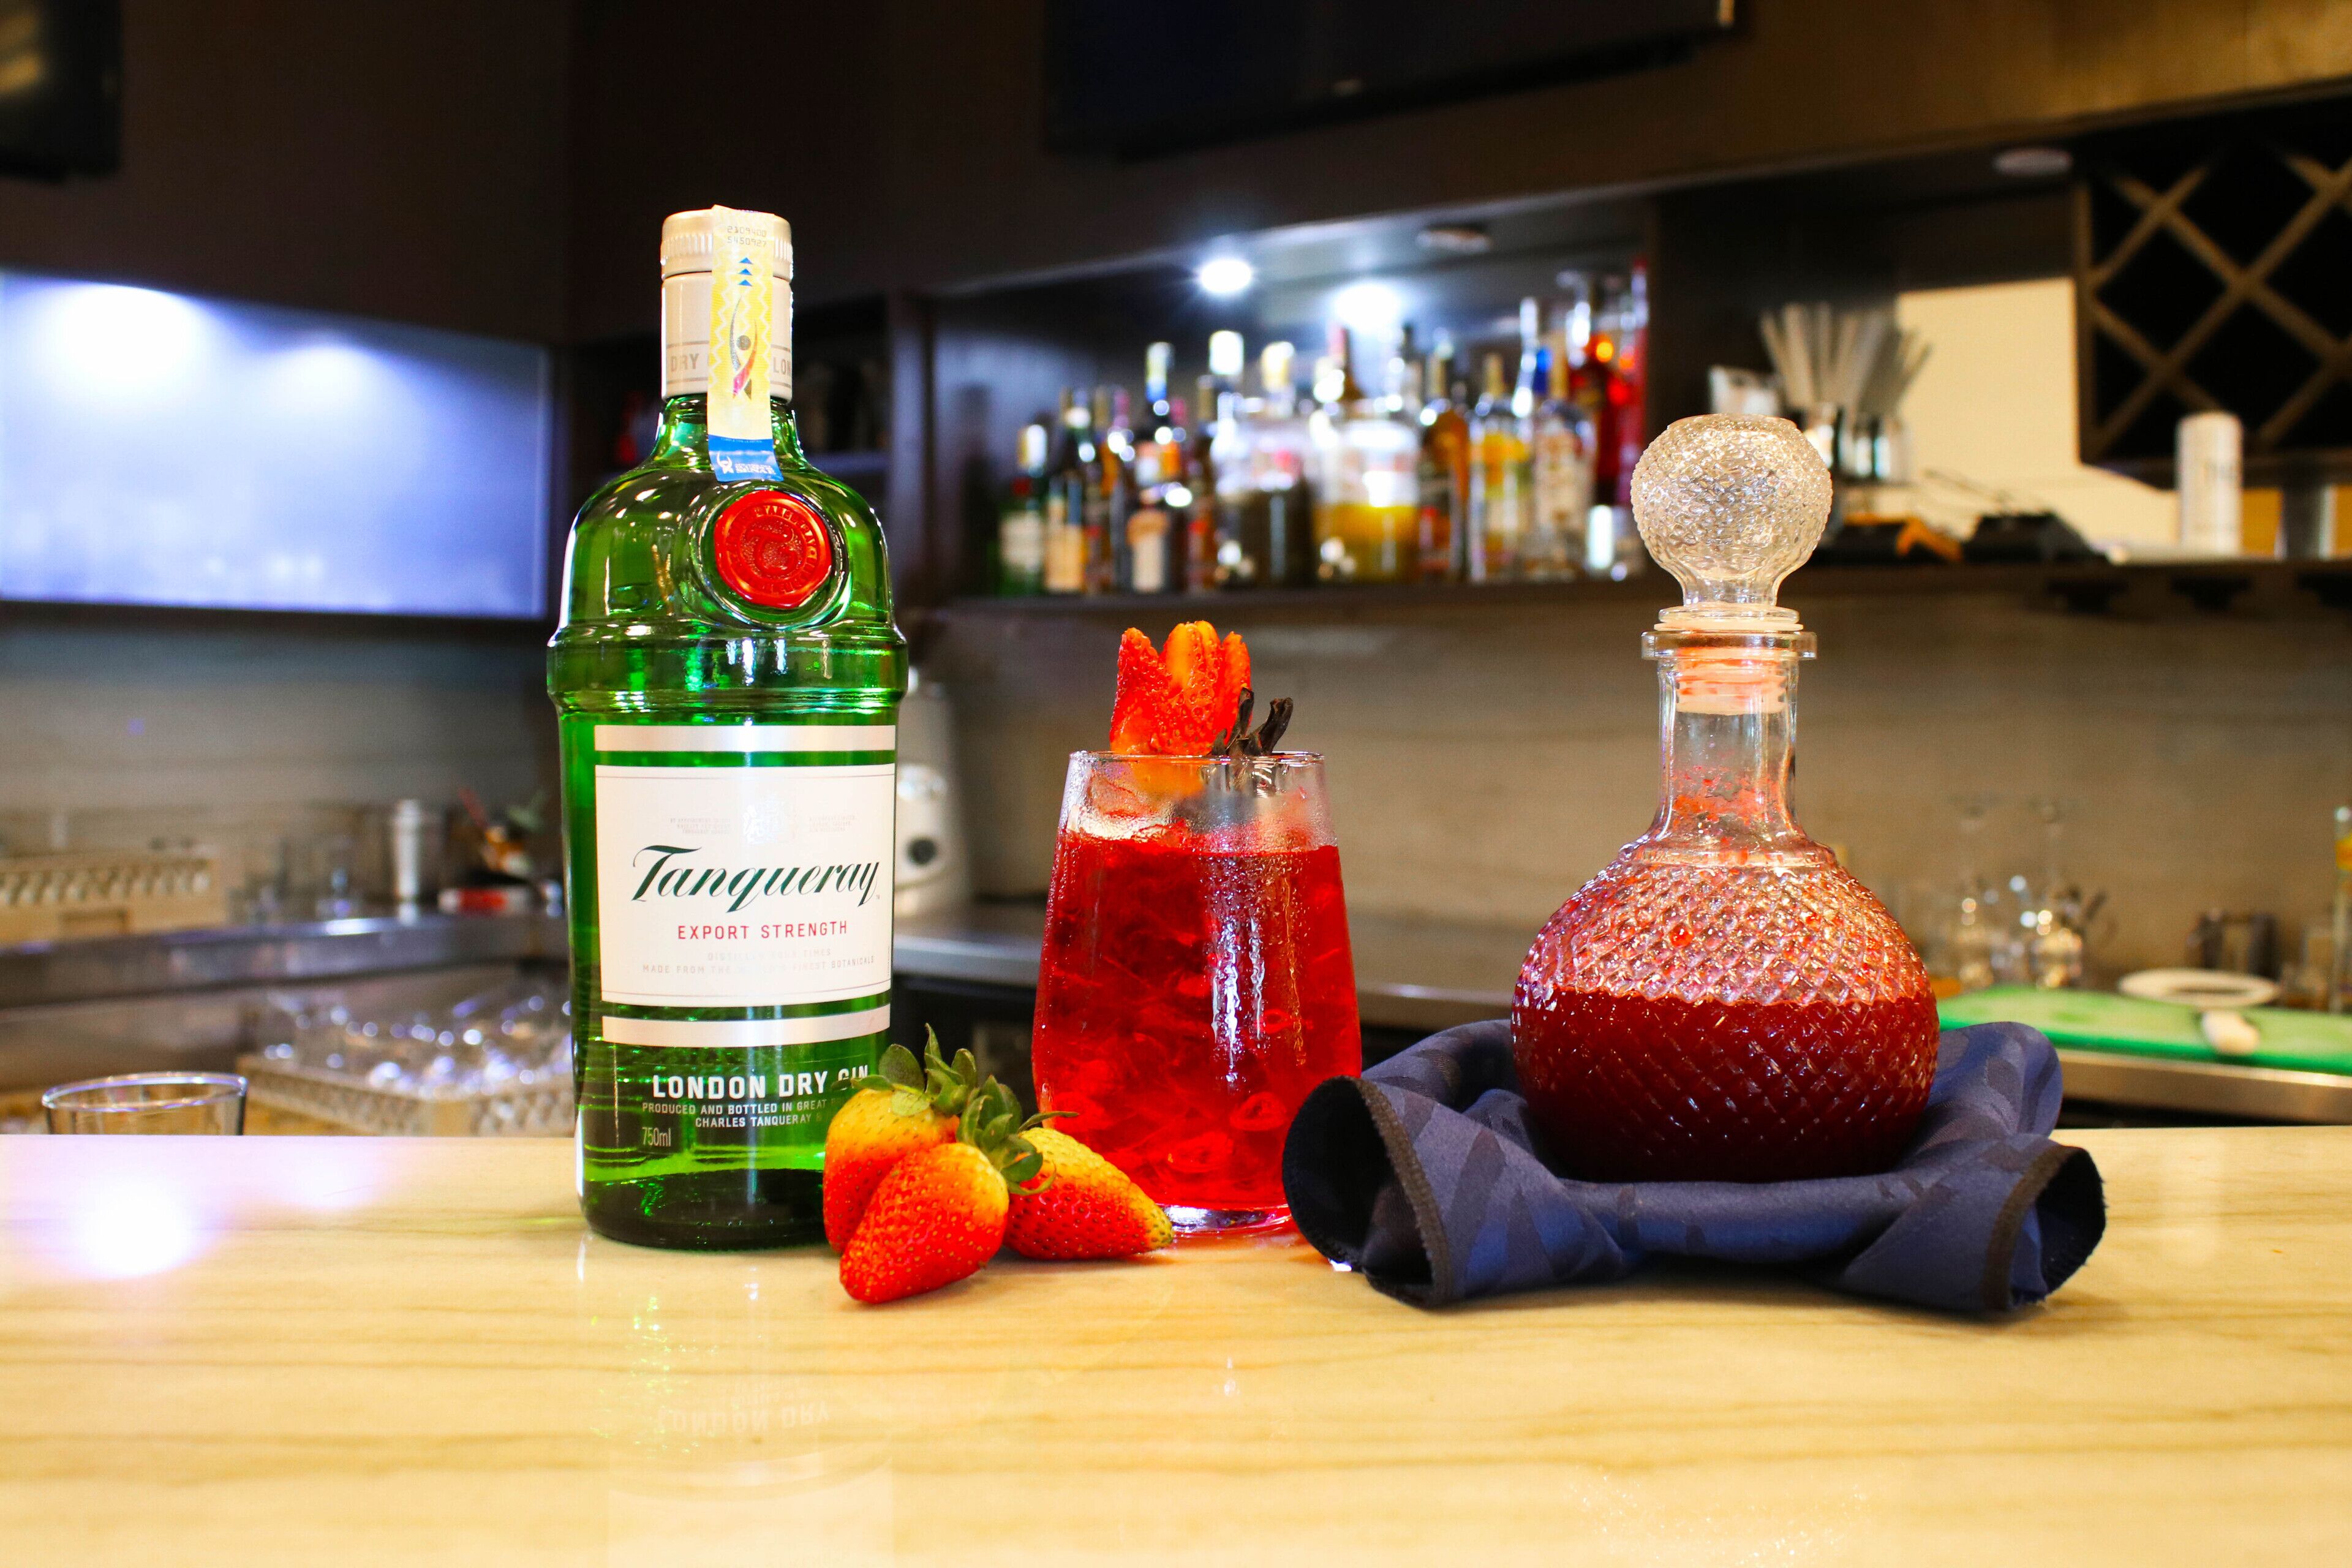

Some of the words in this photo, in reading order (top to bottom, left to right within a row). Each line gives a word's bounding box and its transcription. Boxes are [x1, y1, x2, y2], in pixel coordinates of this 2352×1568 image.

[671, 353, 699, 372] DRY
[631, 845, 880, 913] Tanqueray
[677, 925, 749, 940] EXPORT
[761, 921, 848, 938] STRENGTH
[804, 949, 831, 958] TIMES
[643, 965, 670, 974] MADE
[676, 965, 705, 974] FROM
[710, 965, 731, 974] THE
[831, 956, 874, 969] BOTANICALS
[653, 1074, 766, 1099] LONDON
[778, 1071, 828, 1097] DRY
[642, 1102, 696, 1114] PRODUCED
[701, 1104, 723, 1115] AND
[728, 1103, 777, 1115] BOTTLED
[782, 1102, 793, 1112] IN
[797, 1099, 827, 1112] GREAT
[695, 1117, 746, 1128] CHARLES
[750, 1113, 812, 1127] TANQUERAY
[642, 1127, 671, 1147] 750ml
